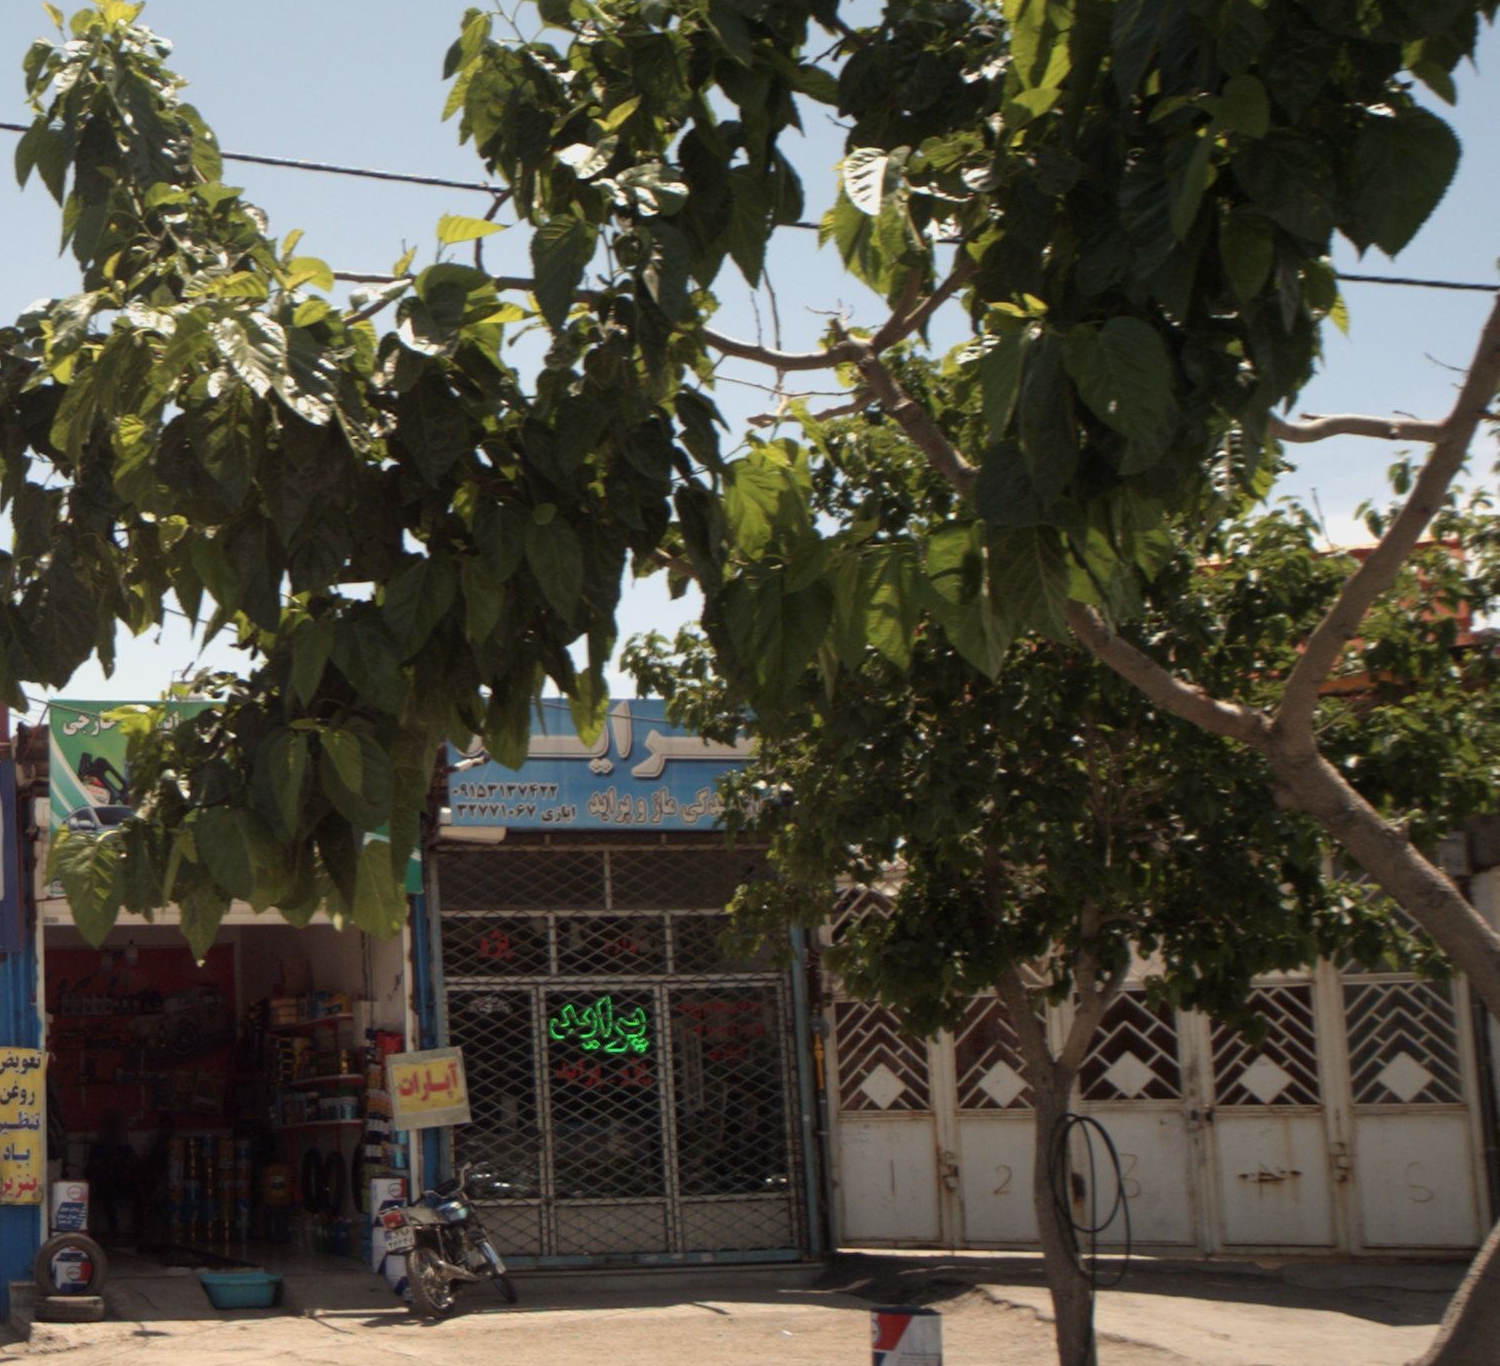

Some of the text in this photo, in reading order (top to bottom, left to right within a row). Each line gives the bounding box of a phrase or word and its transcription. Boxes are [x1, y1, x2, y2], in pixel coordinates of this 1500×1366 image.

[588, 785, 634, 825] پراید
[549, 995, 650, 1053] پراید
[0, 1080, 36, 1106] روغن
